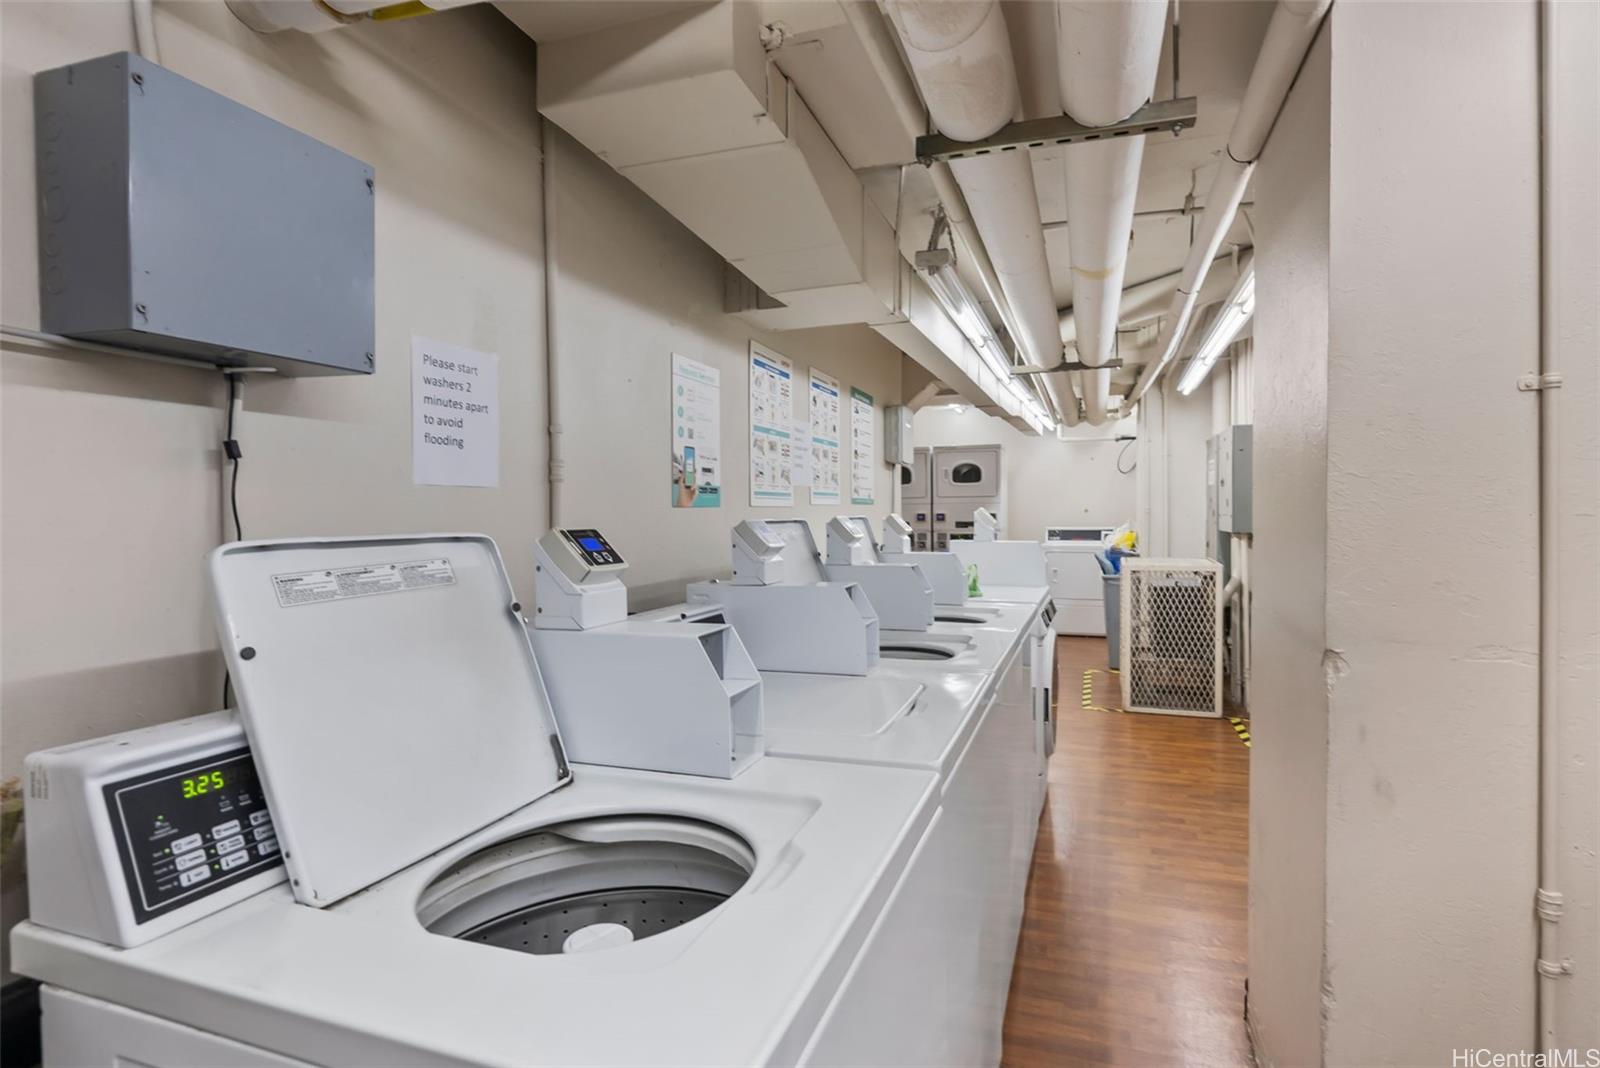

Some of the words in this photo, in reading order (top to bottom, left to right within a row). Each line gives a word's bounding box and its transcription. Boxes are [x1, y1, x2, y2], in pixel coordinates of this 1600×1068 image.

[423, 354, 455, 371] Please
[457, 364, 478, 376] start
[423, 376, 464, 391] washers
[466, 383, 472, 393] 2
[424, 395, 463, 410] minutes
[465, 402, 489, 414] apart
[424, 414, 434, 425] to
[437, 416, 463, 428] avoid
[424, 432, 464, 450] flooding
